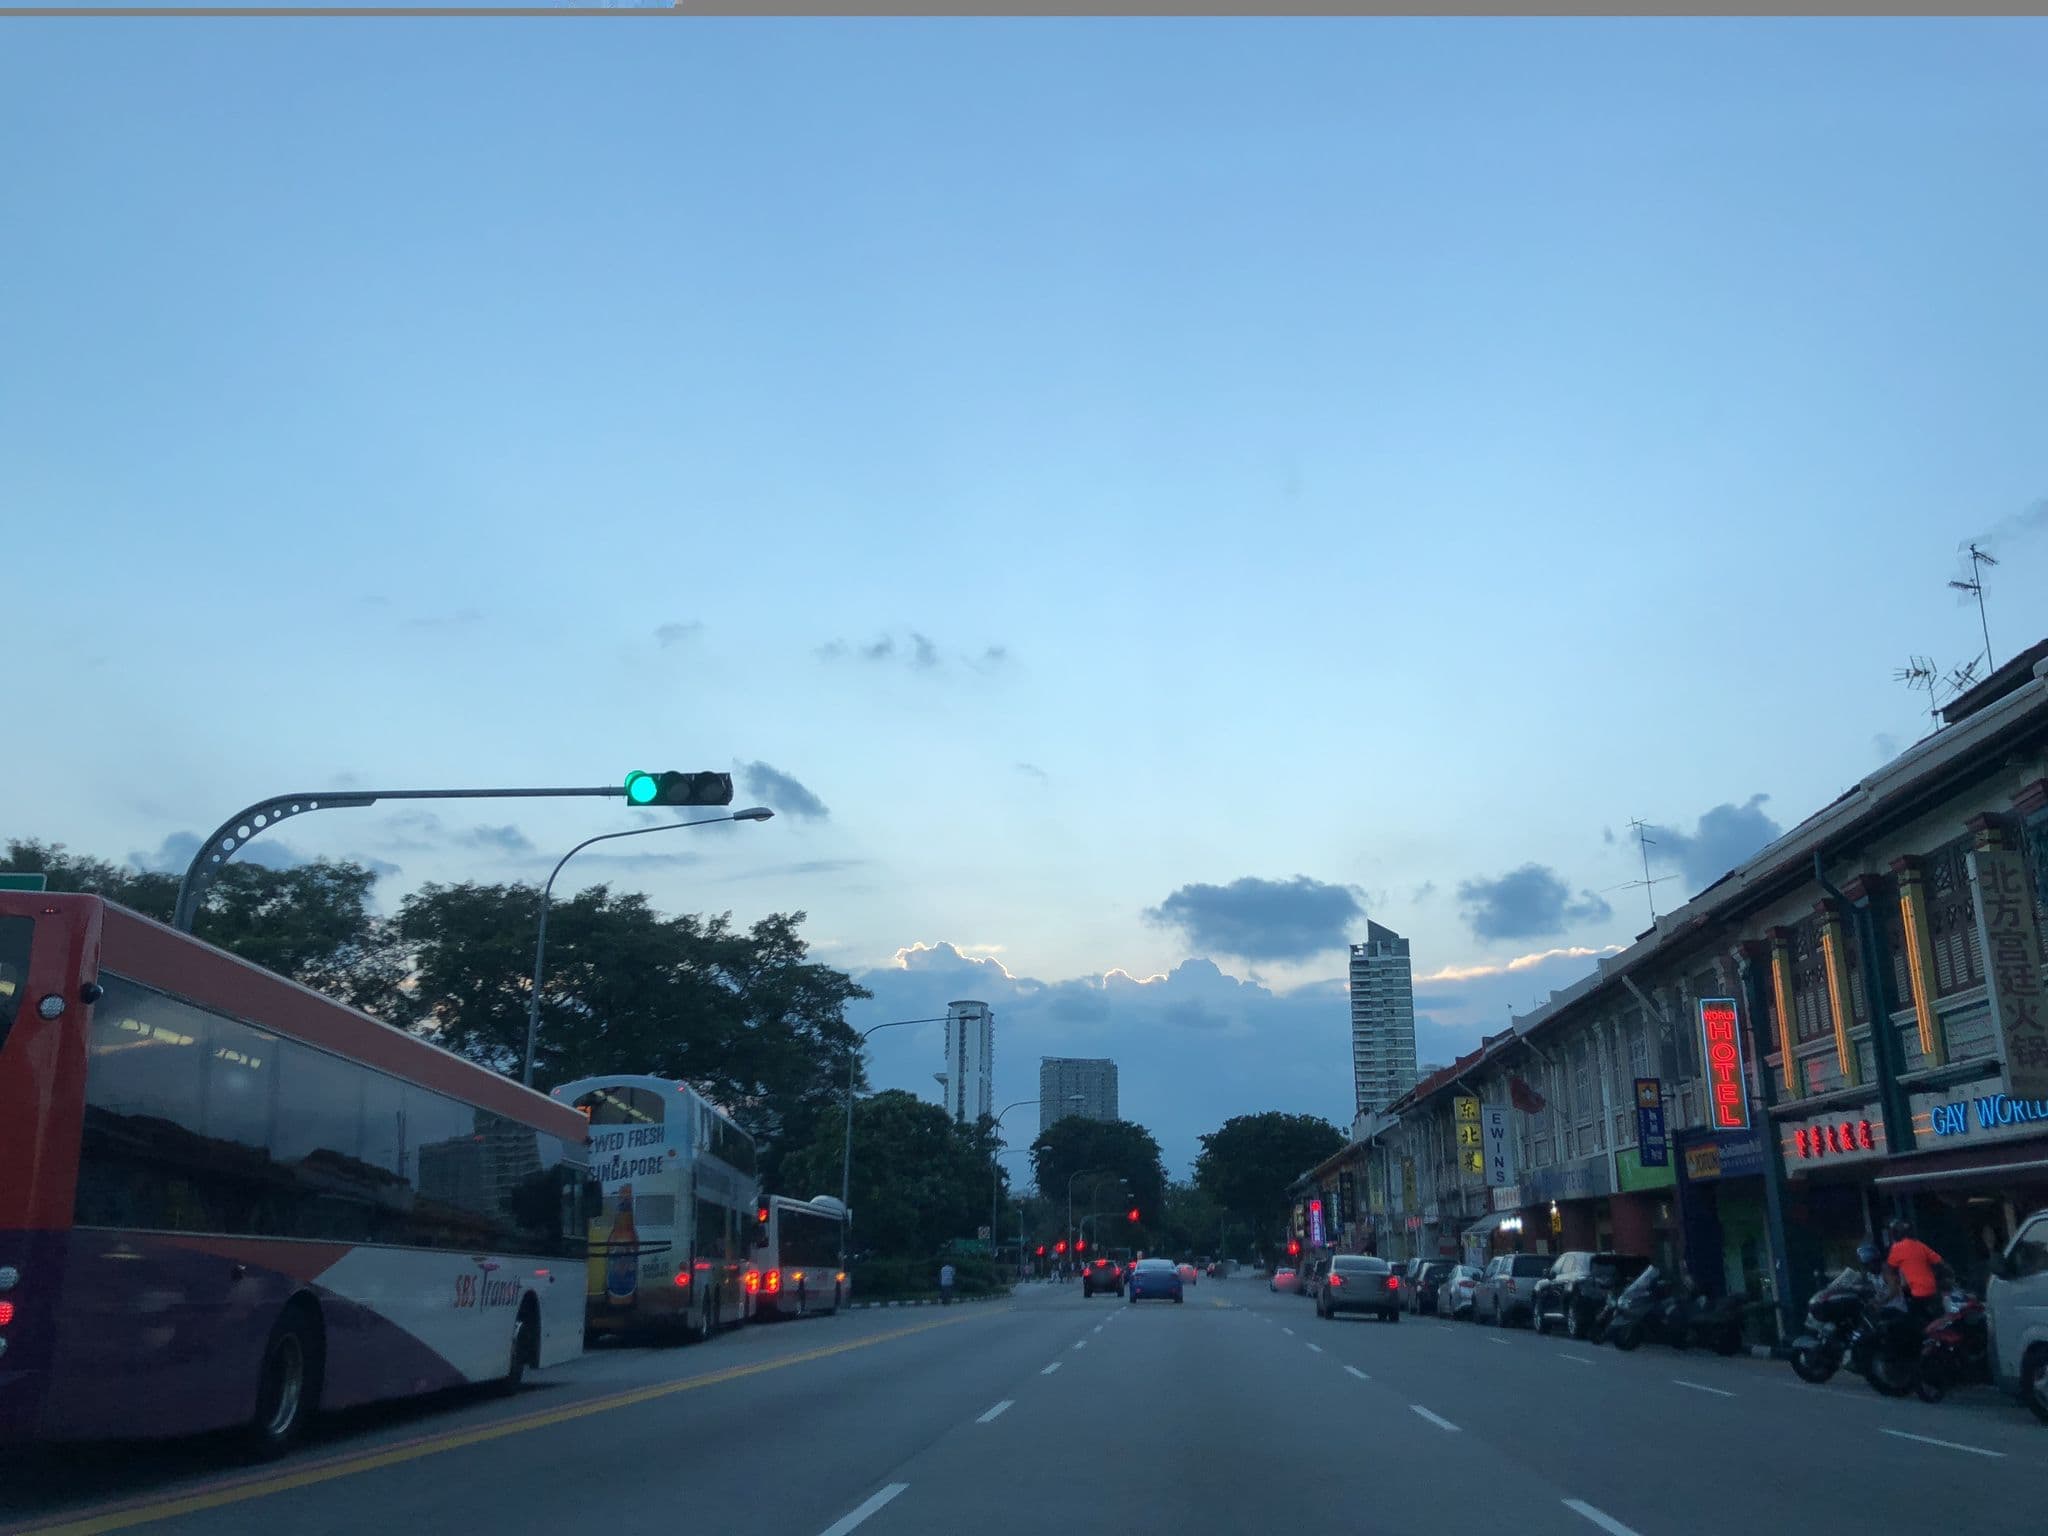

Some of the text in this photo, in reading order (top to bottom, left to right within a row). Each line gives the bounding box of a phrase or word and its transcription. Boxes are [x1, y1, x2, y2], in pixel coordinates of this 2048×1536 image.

[1704, 1010, 1735, 1021] WORLD
[1709, 1021, 1741, 1125] HOTEL
[1460, 1099, 1481, 1172] 东北菜
[1931, 1102, 1967, 1136] GAY
[587, 1127, 664, 1154] WED FRESH
[1490, 1113, 1505, 1183] EWINS
[454, 1274, 477, 1308] SBS
